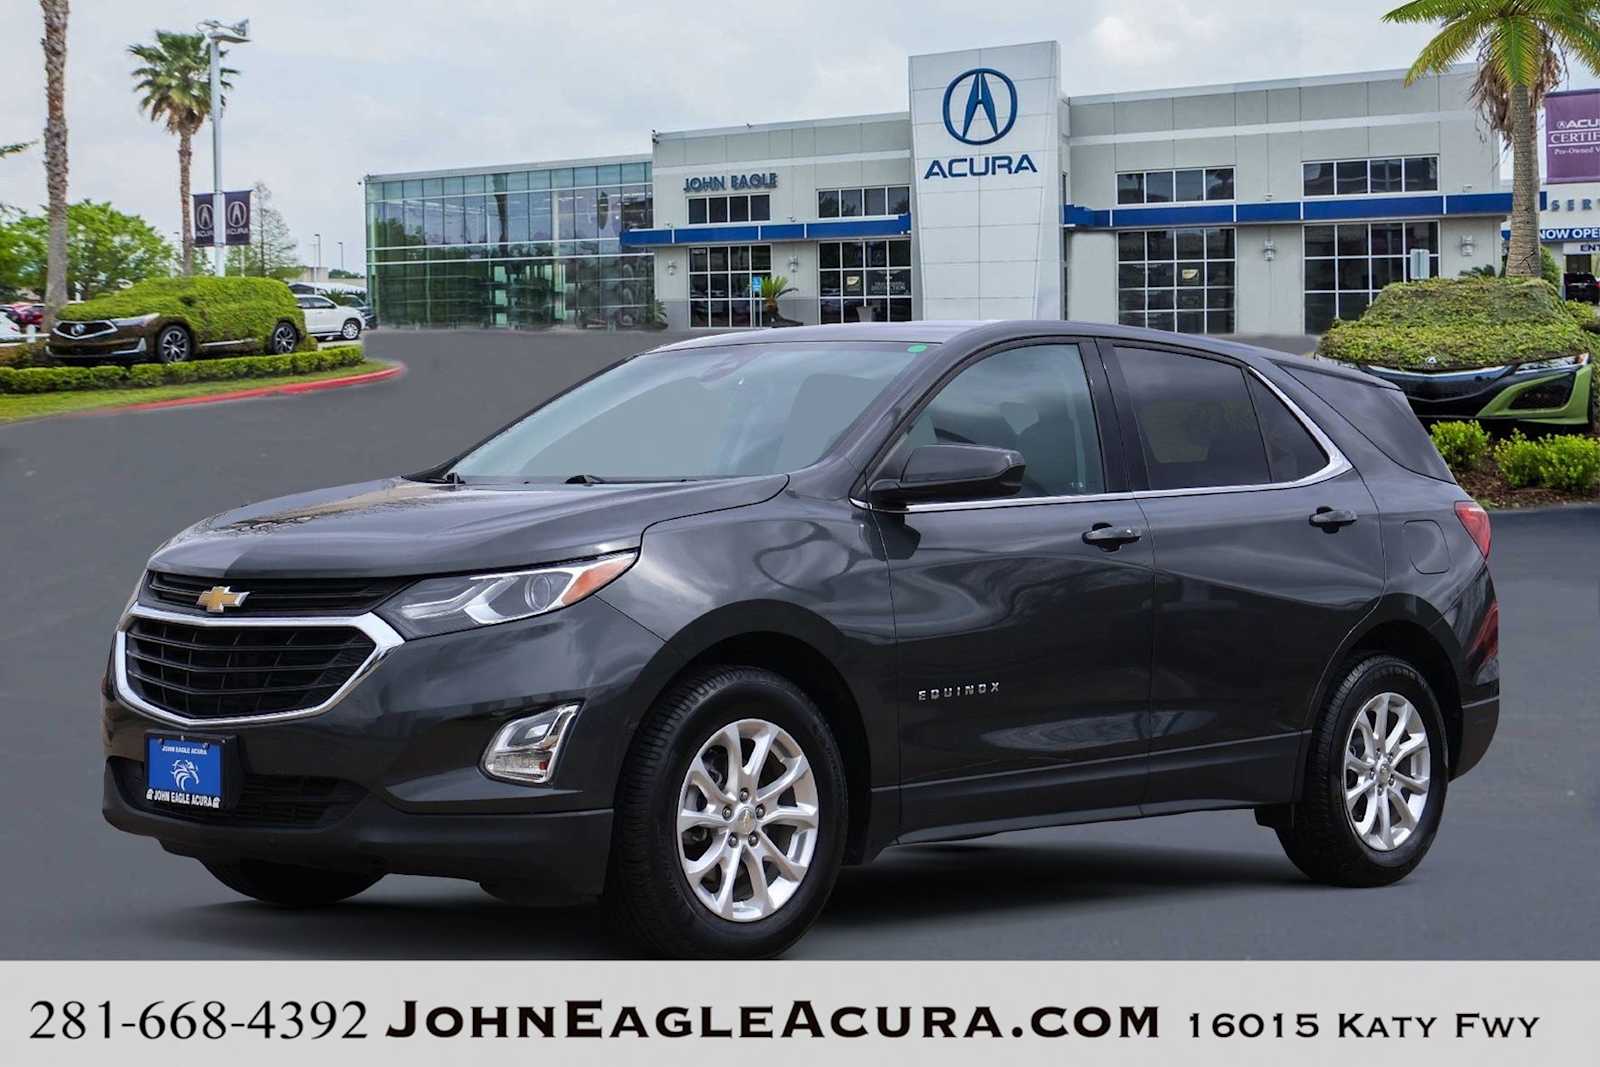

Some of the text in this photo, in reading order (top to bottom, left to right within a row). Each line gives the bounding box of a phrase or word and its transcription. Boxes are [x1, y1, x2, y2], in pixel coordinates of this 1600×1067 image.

[923, 154, 1038, 179] ACURA
[683, 173, 778, 192] JOHN EAGLE
[1572, 228, 1600, 238] OPE
[918, 682, 1000, 700] EQUINOX
[175, 746, 190, 754] EAGLE
[154, 790, 212, 807] JOHN EAGLE ACURA
